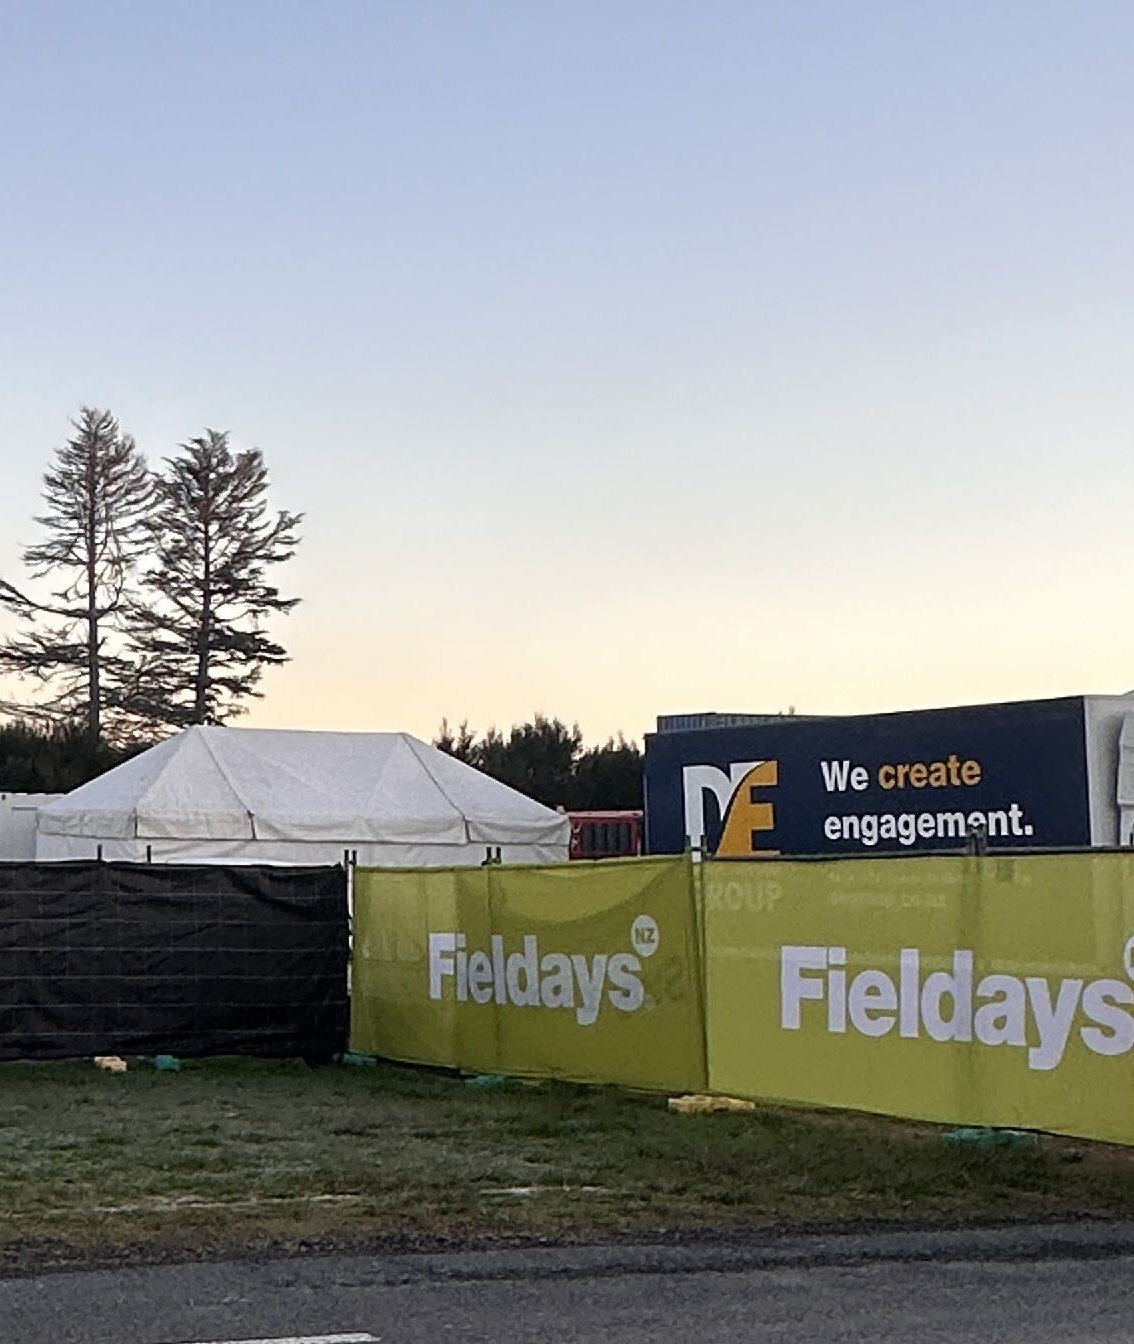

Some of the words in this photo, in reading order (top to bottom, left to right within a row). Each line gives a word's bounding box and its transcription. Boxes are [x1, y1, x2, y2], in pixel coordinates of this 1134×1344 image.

[820, 760, 869, 792] We
[878, 755, 982, 790] create
[824, 803, 1034, 846] engagement.
[428, 933, 644, 1026] Fieldays
[780, 945, 1134, 1071] Fieldays
